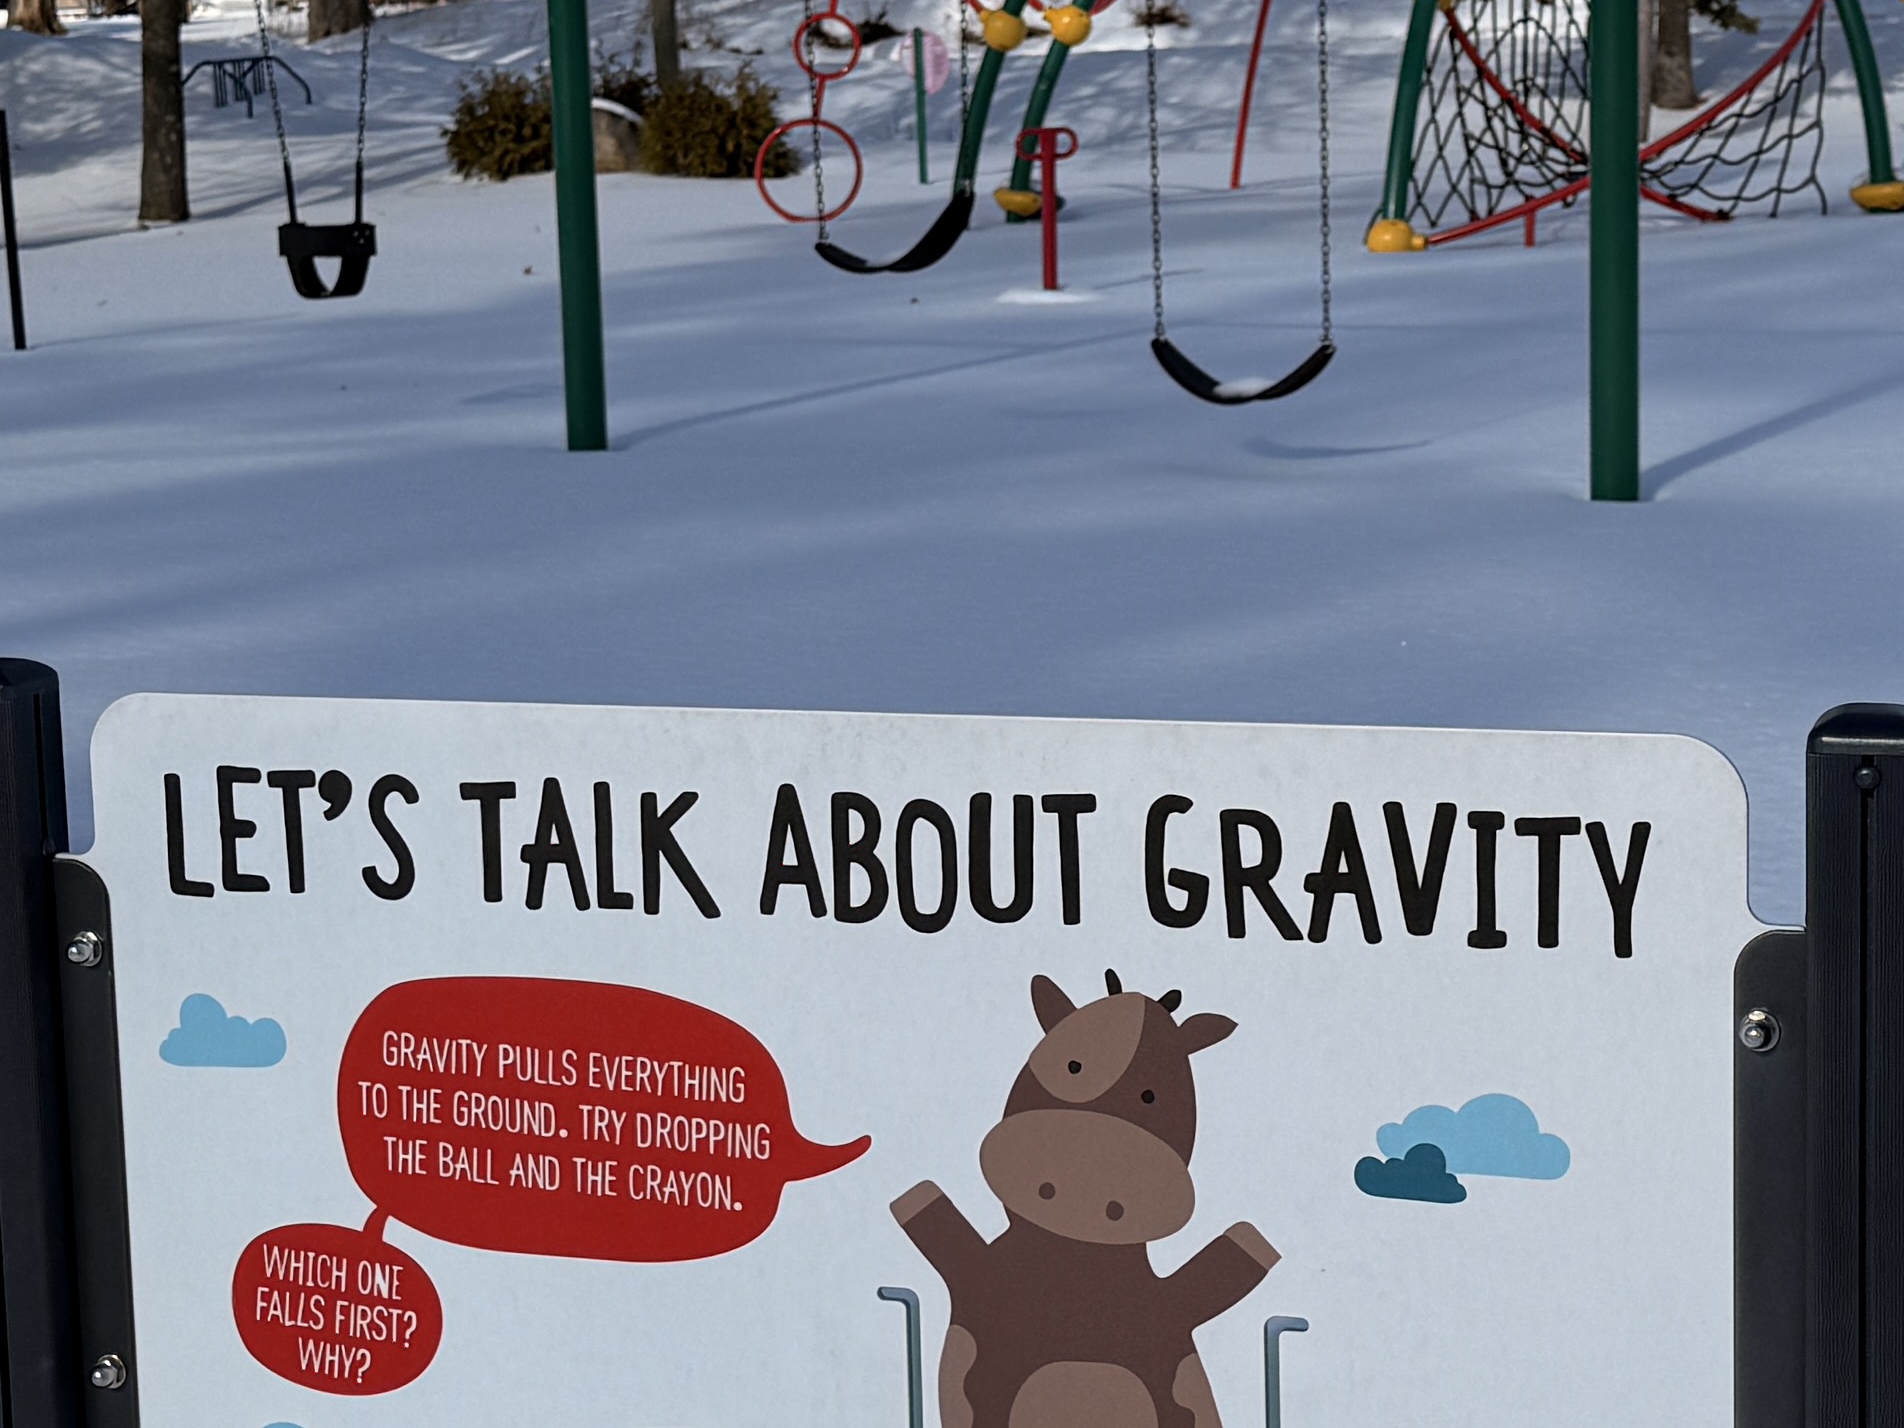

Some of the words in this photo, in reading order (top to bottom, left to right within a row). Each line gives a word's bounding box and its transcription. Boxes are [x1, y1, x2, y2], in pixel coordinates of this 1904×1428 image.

[459, 776, 722, 919] TALK
[760, 783, 1097, 933] ABOUT
[1144, 793, 1652, 959] GRAVITY
[382, 1030, 488, 1078] GRAVITY
[498, 1043, 578, 1087] PULLS
[588, 1052, 746, 1104] EVERYTHING
[358, 1081, 388, 1119] TO
[397, 1085, 442, 1125] THE
[453, 1090, 569, 1139] GROUND.
[578, 1104, 628, 1145] TRY
[636, 1112, 772, 1160] DROPPING
[383, 1136, 428, 1175] THE
[438, 1142, 500, 1186] BALL
[509, 1152, 561, 1191] AND
[571, 1157, 619, 1197] THE
[628, 1164, 744, 1212] CRAYON.
[263, 1243, 347, 1293] WHICH
[357, 1260, 405, 1300] ONE
[256, 1286, 325, 1330] FALLS
[334, 1300, 418, 1349] FIRST?
[298, 1337, 372, 1384] WHY?
